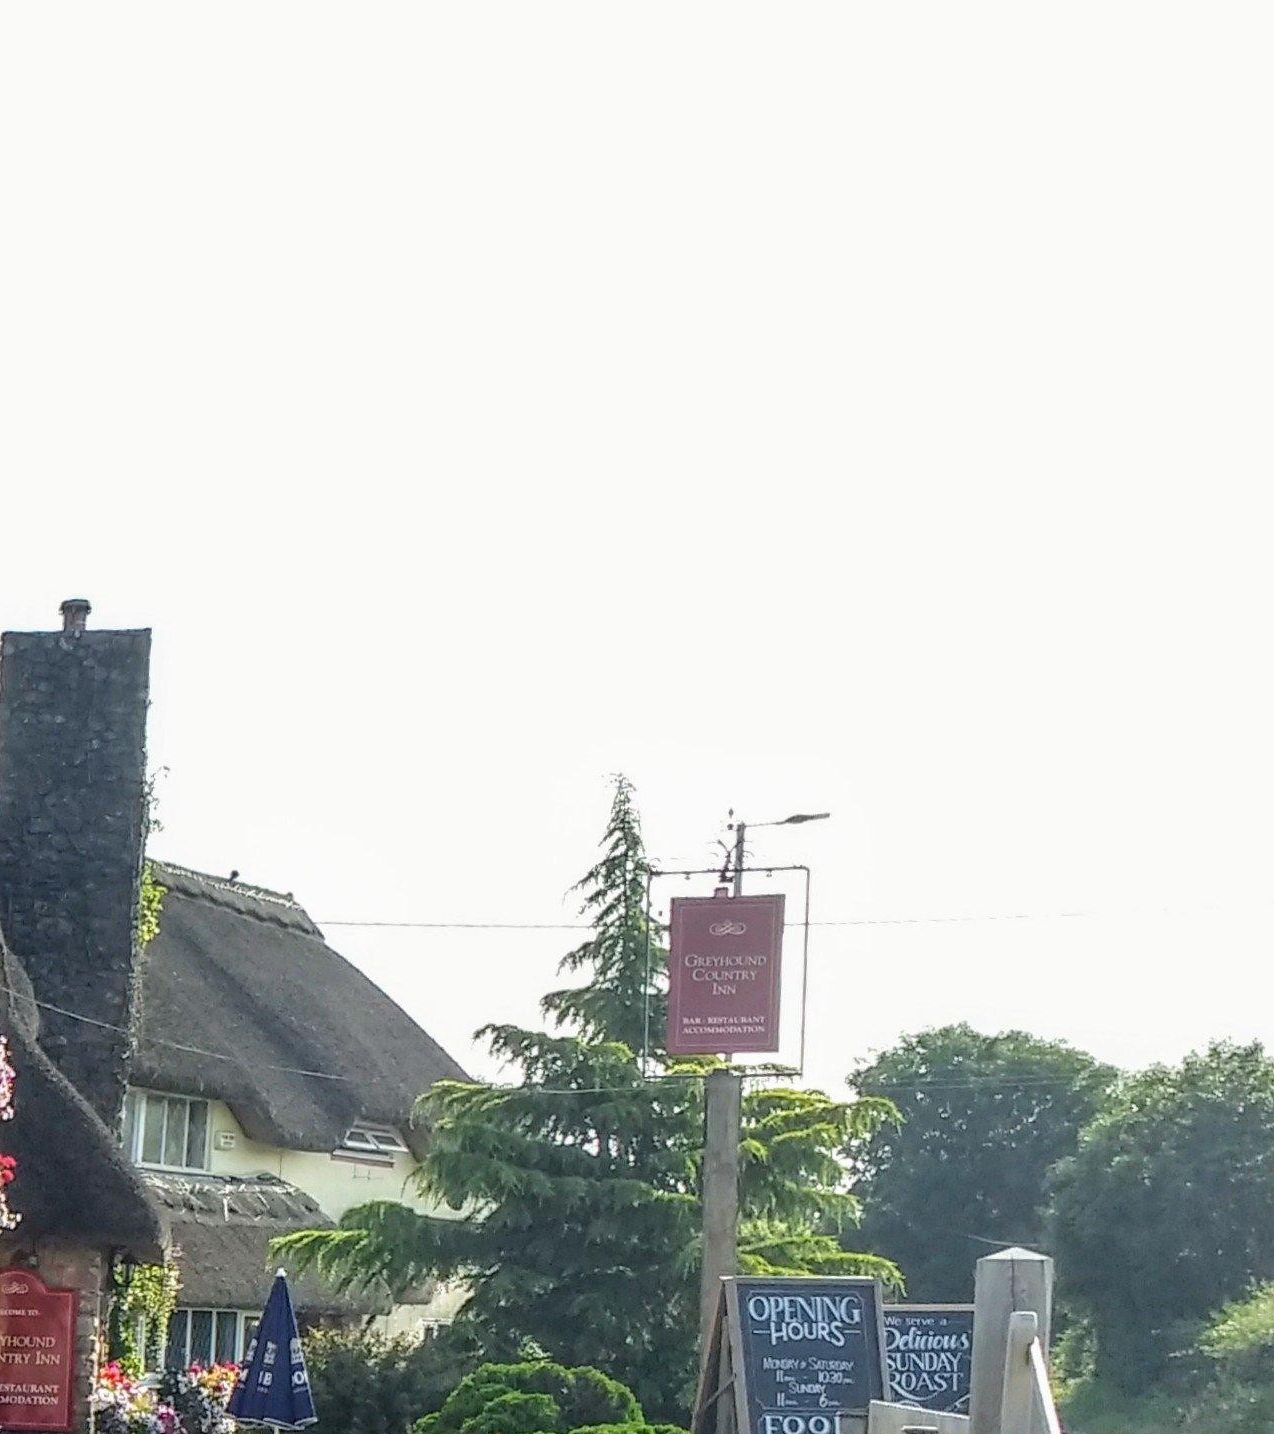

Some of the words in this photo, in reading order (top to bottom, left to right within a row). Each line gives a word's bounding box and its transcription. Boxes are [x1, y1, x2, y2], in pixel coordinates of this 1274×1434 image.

[684, 953, 767, 968] GREYHOUND
[692, 968, 757, 981] COUNTRY
[712, 982, 737, 995] INN
[707, 1016, 766, 1024] RESTAURANT
[682, 1026, 765, 1034] ACCOMMODATION
[749, 1296, 862, 1324] OPENING
[885, 1316, 902, 1326] We
[906, 1317, 935, 1326] serve
[770, 1321, 845, 1347] HOURS
[33, 1350, 61, 1365] INN
[763, 1357, 799, 1370] MONDAY
[808, 1357, 854, 1371] SATURDAY
[886, 1352, 962, 1372] SUNDAY
[789, 1381, 827, 1394] SUNDAY
[889, 1372, 964, 1399] ROAST
